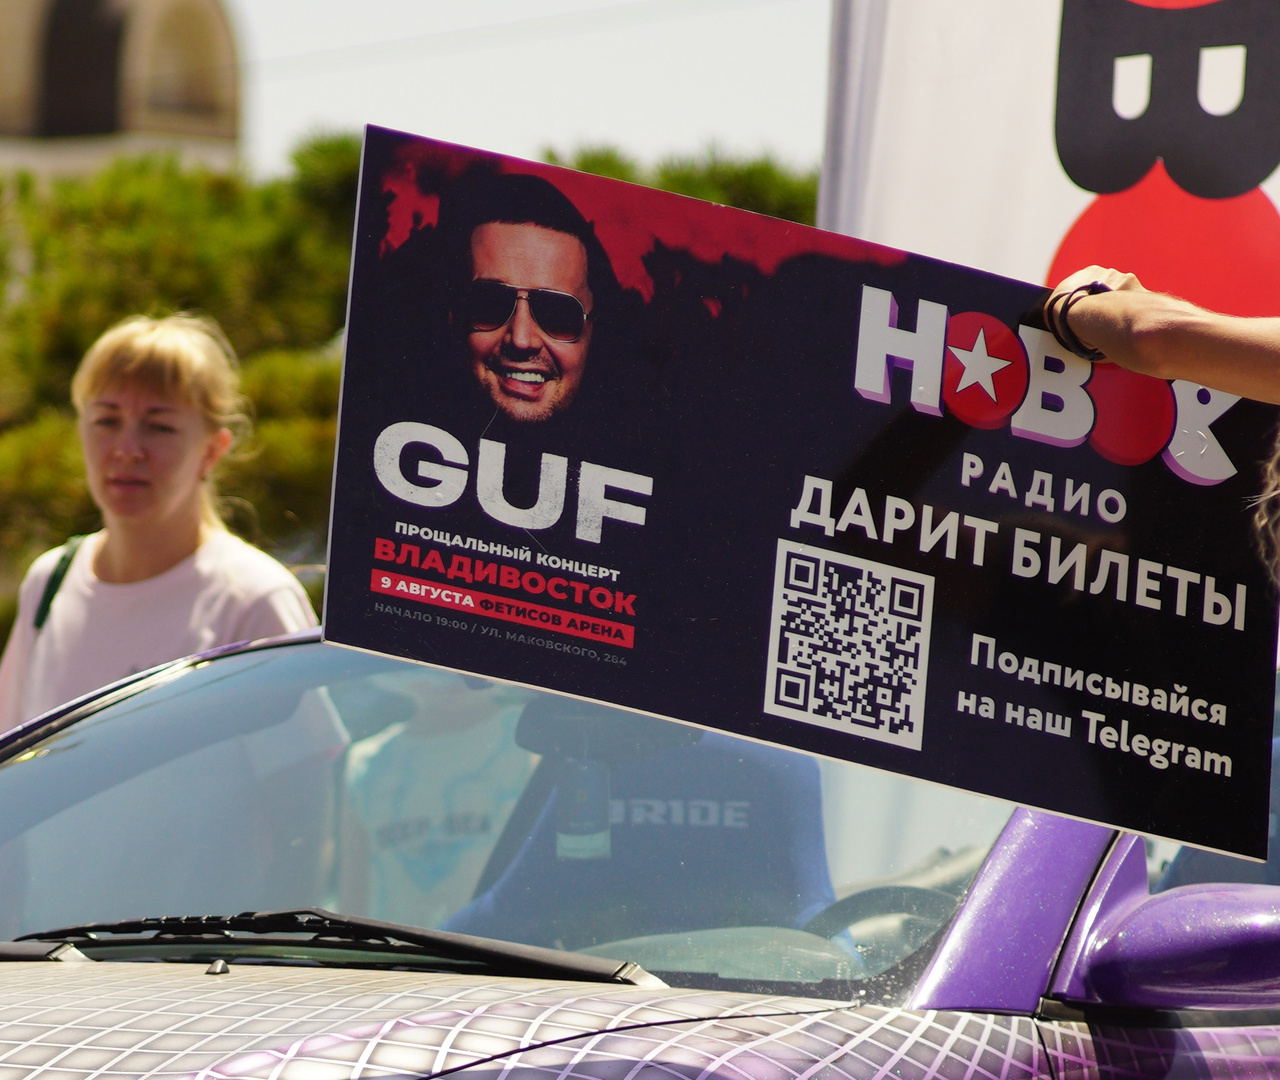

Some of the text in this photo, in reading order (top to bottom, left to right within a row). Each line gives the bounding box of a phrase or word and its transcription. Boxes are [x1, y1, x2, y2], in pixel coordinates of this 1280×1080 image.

[373, 421, 653, 544] GUF
[961, 452, 1127, 524] РАДИО
[374, 537, 638, 616] ВЛАДИВОСТОК
[395, 521, 621, 583] ПРОЩАЛЬНЫЙ КОНЦЕРТ
[790, 474, 1247, 631] ДАРИТ БИЛЕТЫ
[375, 602, 432, 624] НАЧАЛО
[436, 617, 468, 631] 19:00
[380, 576, 625, 641] 9 АВГУСТА ФЕТИСОВ АРЕНА
[970, 633, 1228, 728] Подписывайся
[957, 690, 1233, 778] на наш Telegram
